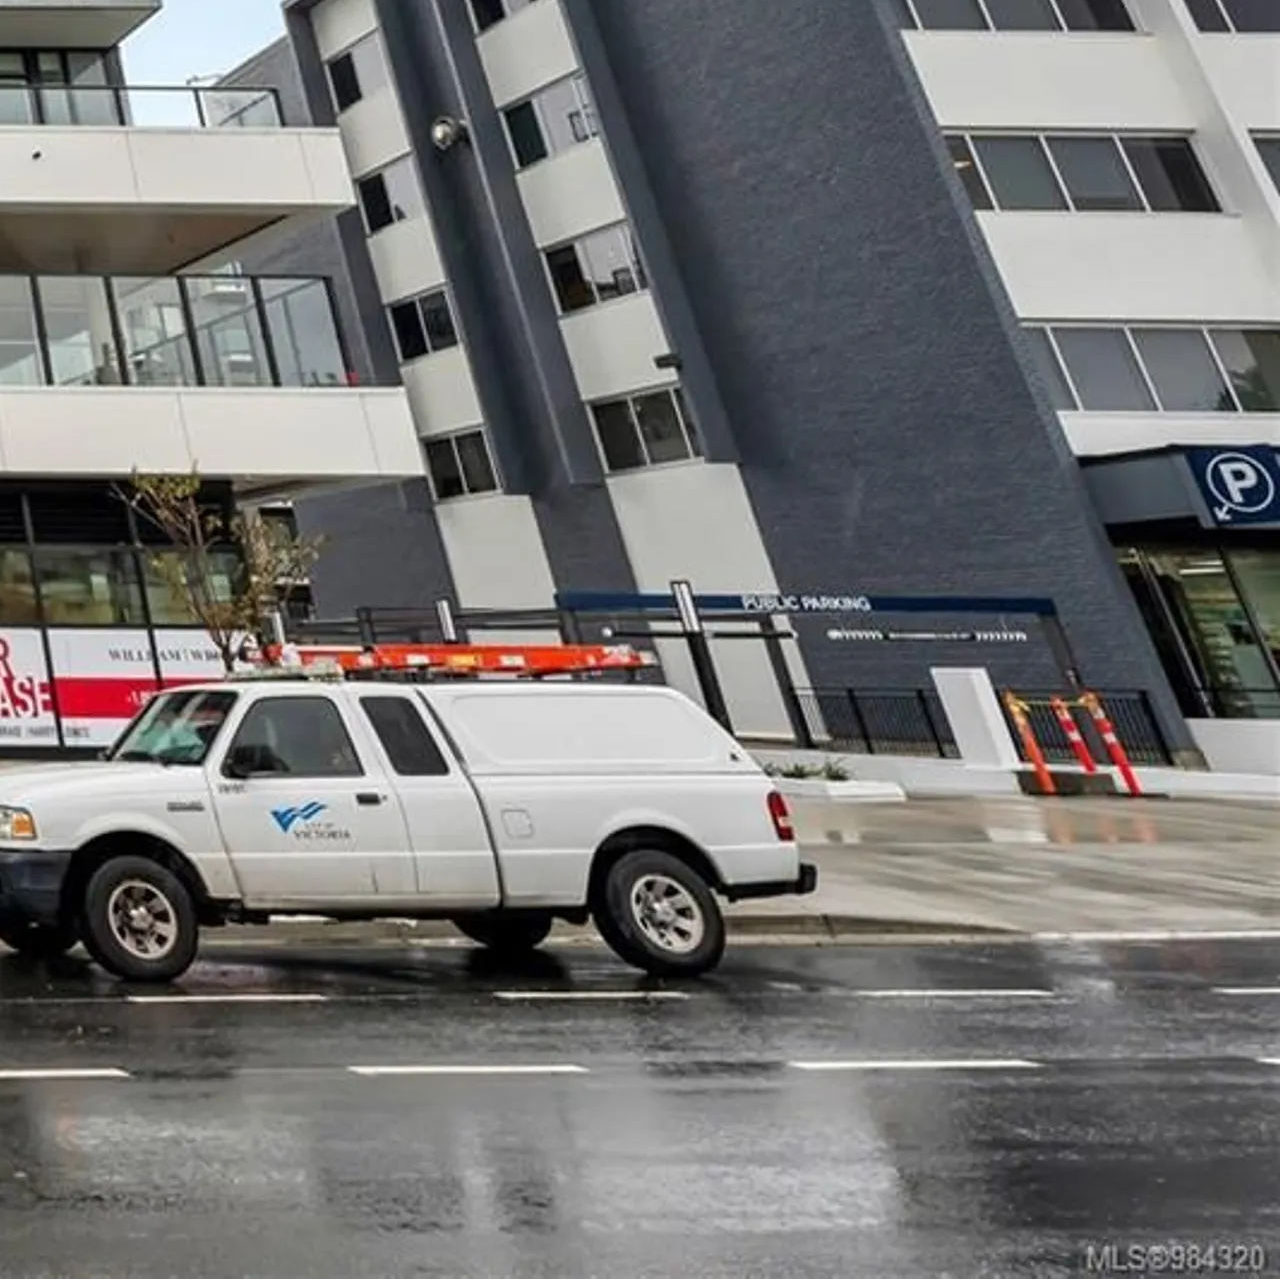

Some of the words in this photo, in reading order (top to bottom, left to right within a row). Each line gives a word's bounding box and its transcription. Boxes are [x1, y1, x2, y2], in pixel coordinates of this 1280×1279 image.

[1218, 462, 1258, 503] P
[742, 596, 799, 611] PUBLIC
[801, 596, 871, 611] PARKING
[293, 830, 351, 840] VICTORIA
